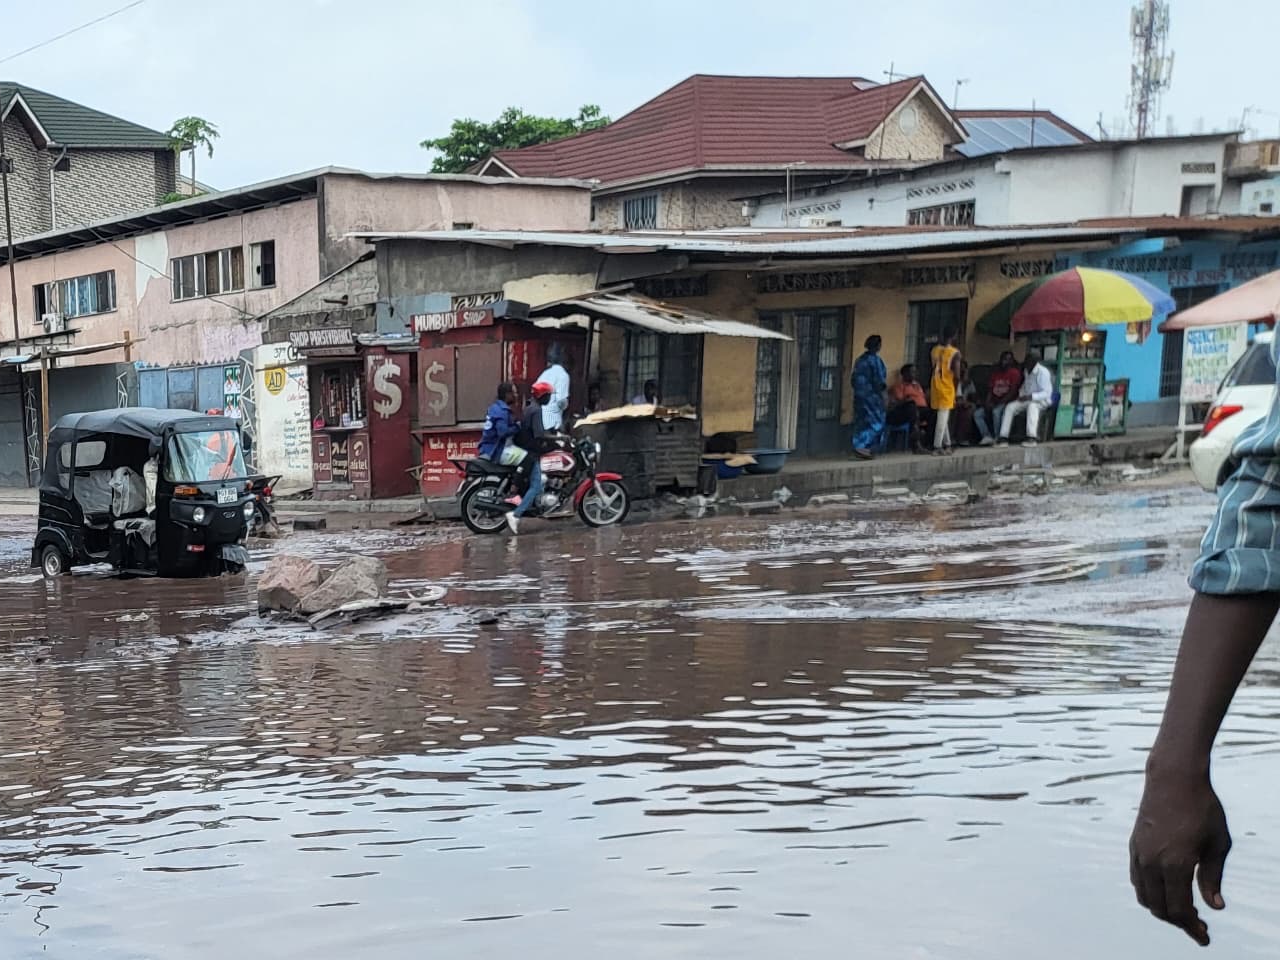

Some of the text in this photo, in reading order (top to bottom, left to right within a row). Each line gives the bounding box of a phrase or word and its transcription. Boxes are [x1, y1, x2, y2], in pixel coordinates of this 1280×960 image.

[463, 311, 486, 327] SHOP
[289, 331, 309, 347] SHOP
[269, 371, 282, 388] AD
